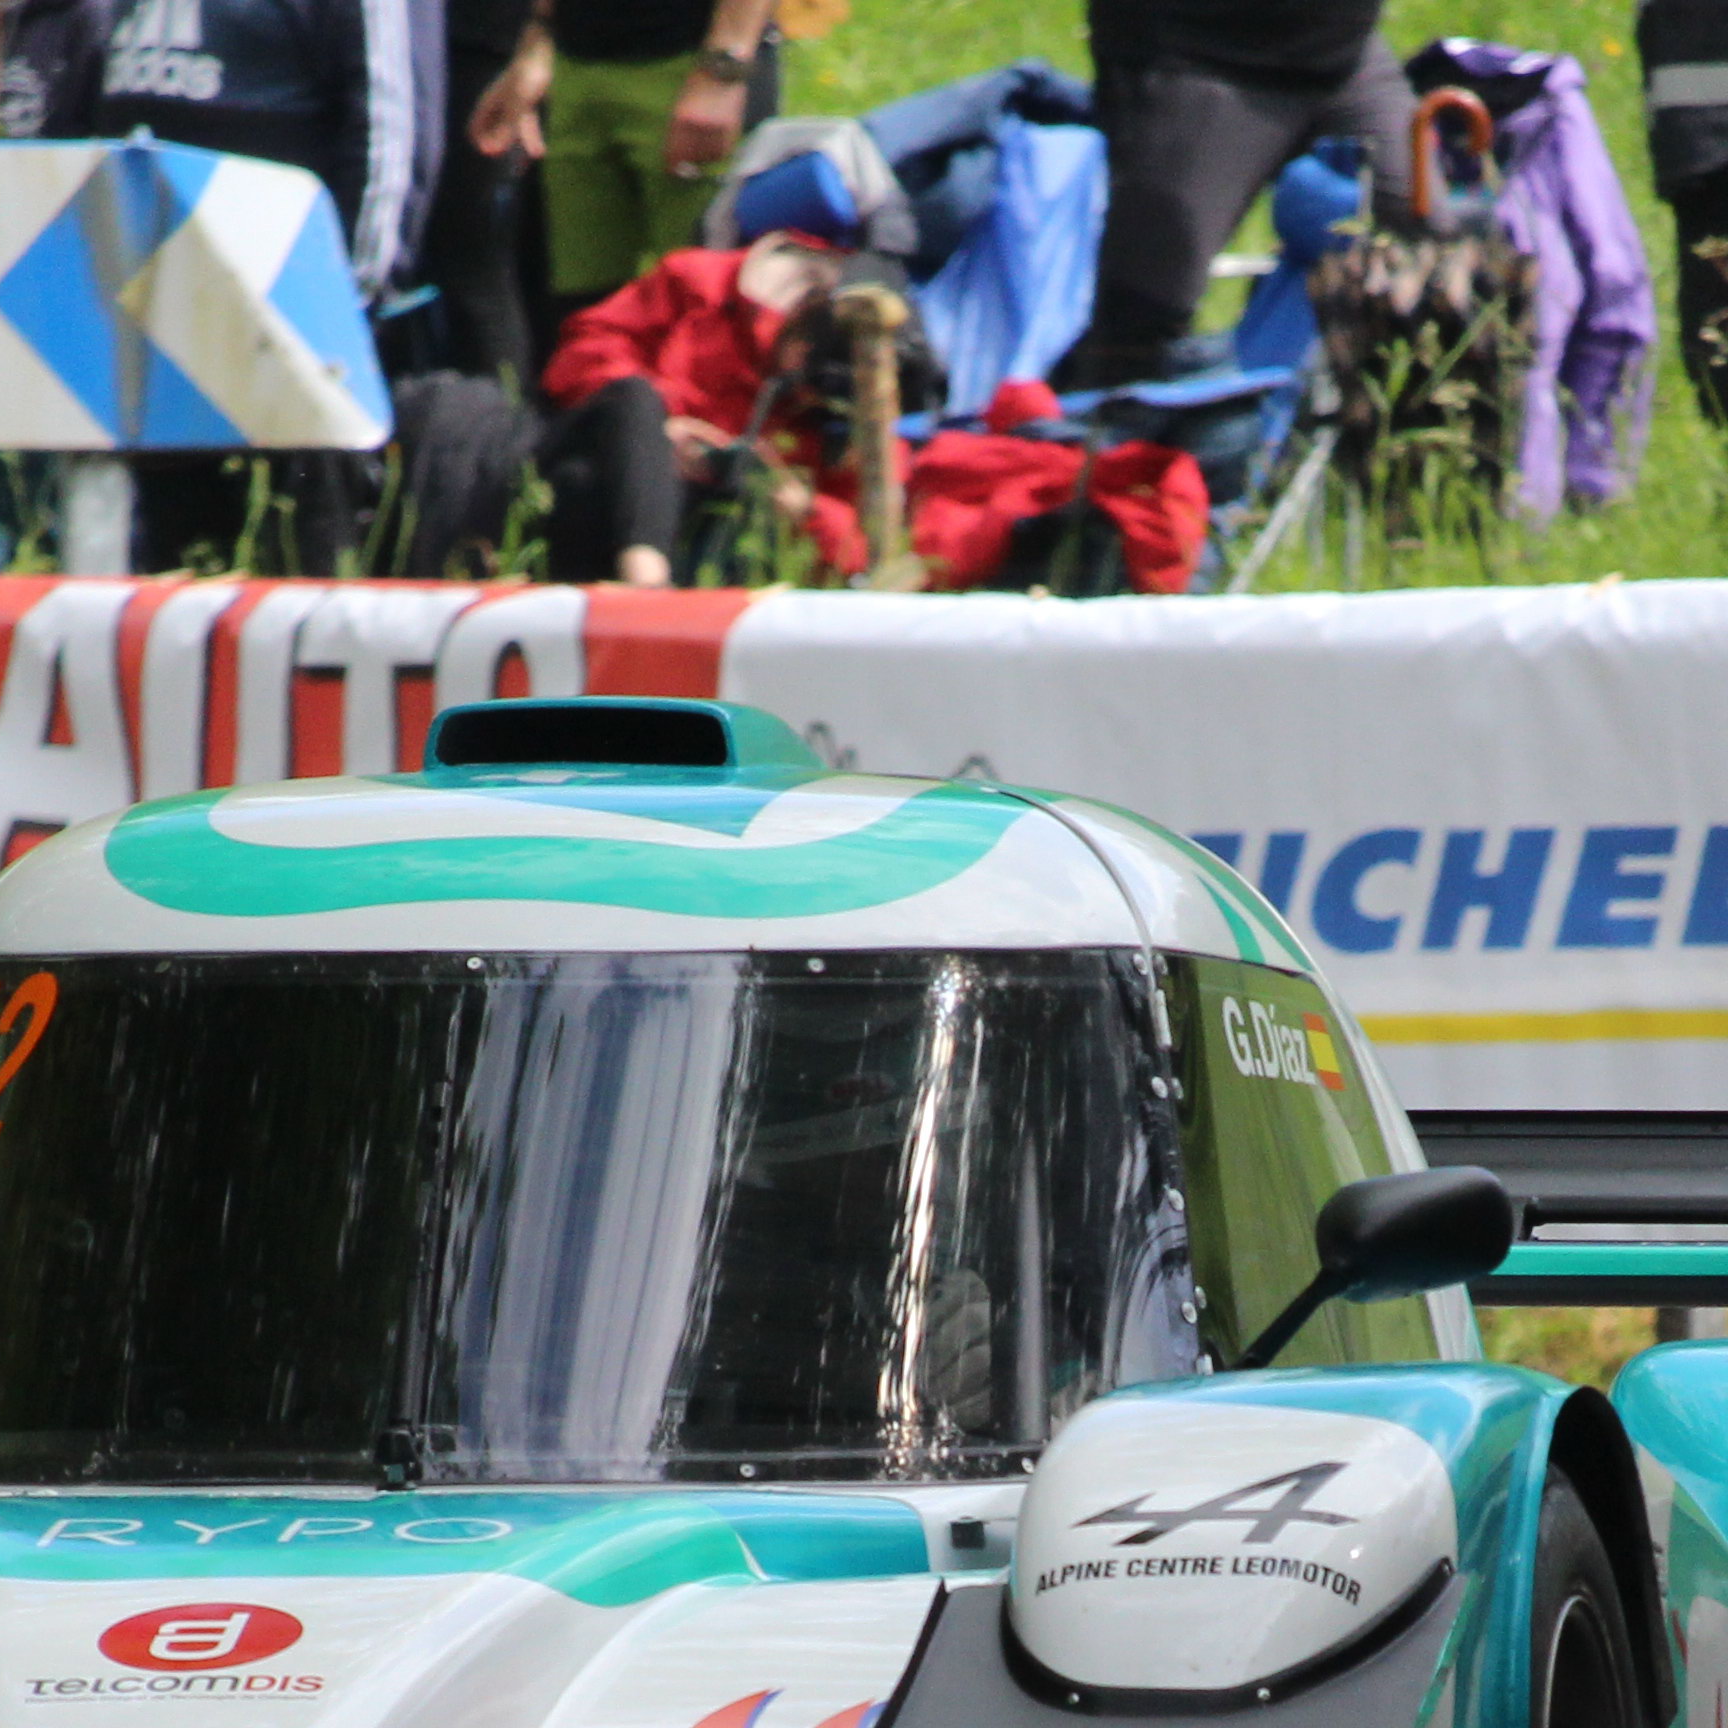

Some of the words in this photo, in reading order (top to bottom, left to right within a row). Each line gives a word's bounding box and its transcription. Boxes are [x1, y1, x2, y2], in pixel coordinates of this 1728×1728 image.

[35, 1517, 513, 1548] RYPO
[1035, 1557, 1118, 1596] ALPINE
[1126, 1557, 1223, 1579] CENTRE
[1232, 1555, 1363, 1606] LEOMOTOR
